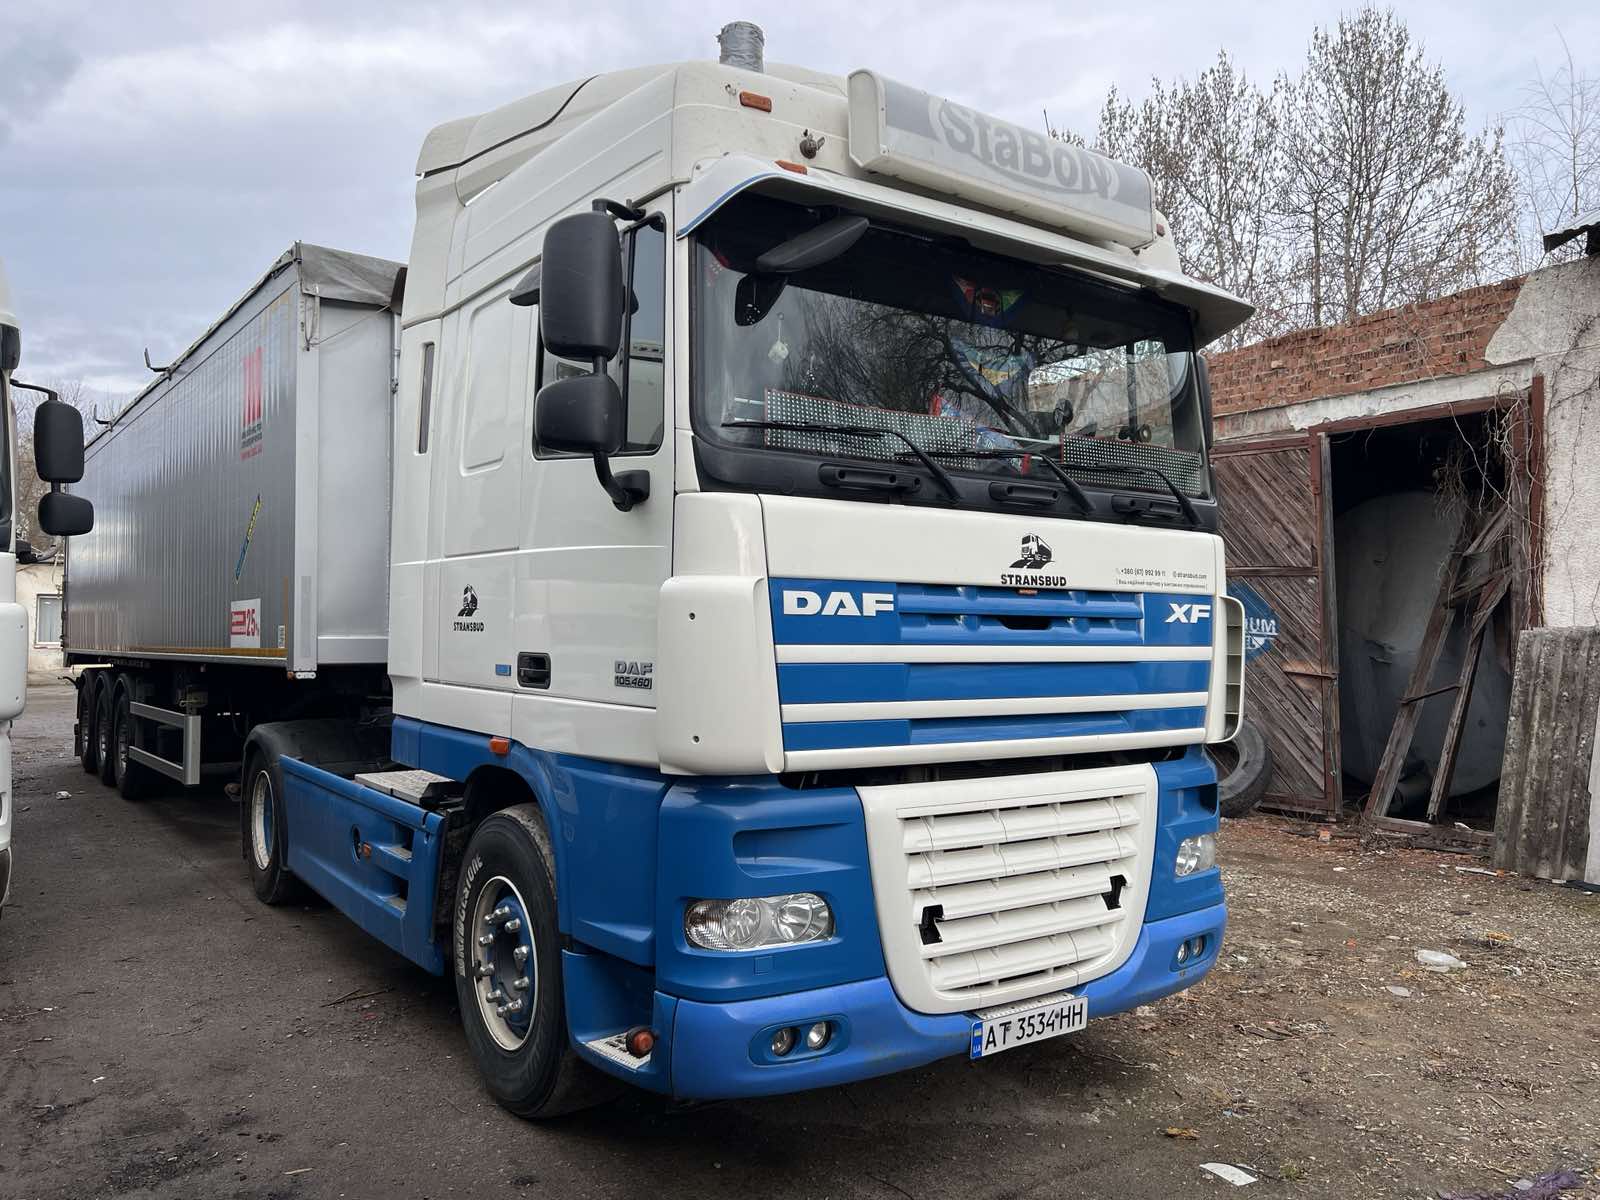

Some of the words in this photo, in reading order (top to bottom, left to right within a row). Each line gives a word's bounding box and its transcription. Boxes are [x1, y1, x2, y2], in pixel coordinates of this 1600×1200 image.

[1001, 573, 1067, 587] STRANSBUD
[783, 590, 895, 617] DAF
[1164, 603, 1211, 624] XF
[453, 621, 485, 632] STRANSBUD
[614, 661, 653, 676] DAF
[985, 1021, 1012, 1050] AT
[1016, 1009, 1055, 1041] 3534
[1060, 1003, 1083, 1030] HH
